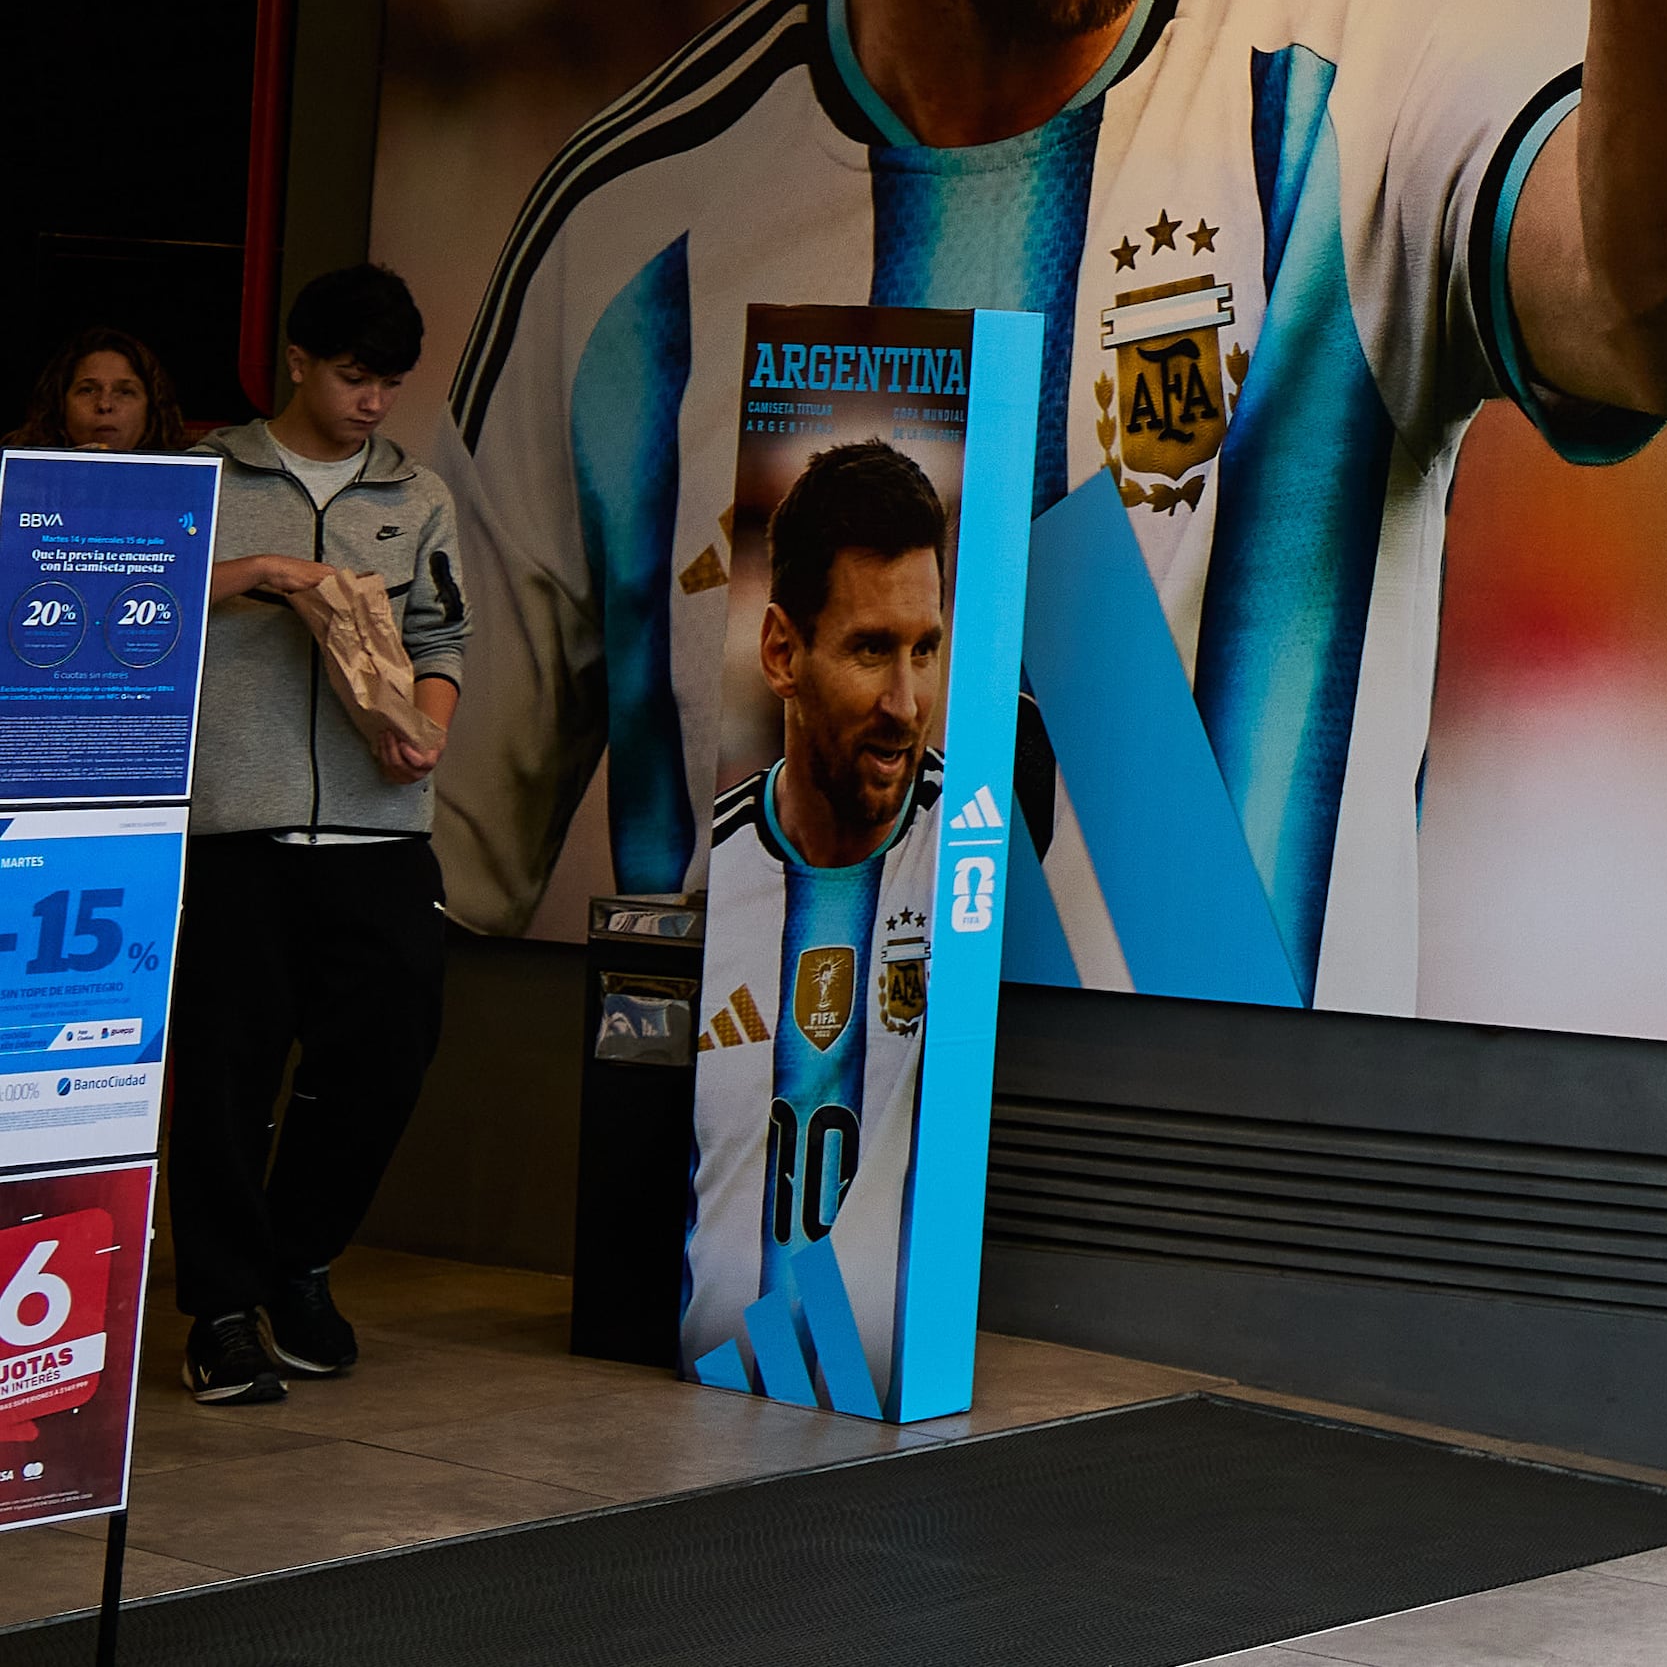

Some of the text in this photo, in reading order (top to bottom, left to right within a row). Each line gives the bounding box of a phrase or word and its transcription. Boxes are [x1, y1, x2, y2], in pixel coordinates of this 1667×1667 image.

[747, 341, 968, 396] ARGENTINA
[1126, 338, 1219, 444] AFA
[746, 401, 834, 417] CAMISETA TITULAR
[921, 408, 966, 423] MUNDIAL
[19, 513, 64, 527] BBVA
[41, 534, 70, 544] Martes
[70, 535, 80, 544] 14
[136, 537, 147, 546] de
[31, 548, 177, 563] Que la previa te encuentre
[40, 561, 165, 575] con la camiseta puesta
[21, 599, 77, 627] 20%
[117, 598, 172, 626] 20%
[61, 670, 88, 680] cuotas
[1, 856, 44, 869] MARTES
[1, 981, 124, 999] SIN TOPE DE REINTEGRO
[810, 1011, 839, 1026] FIFA
[0, 1240, 72, 1347] 6
[12, 1370, 61, 1393] INTERÉS
